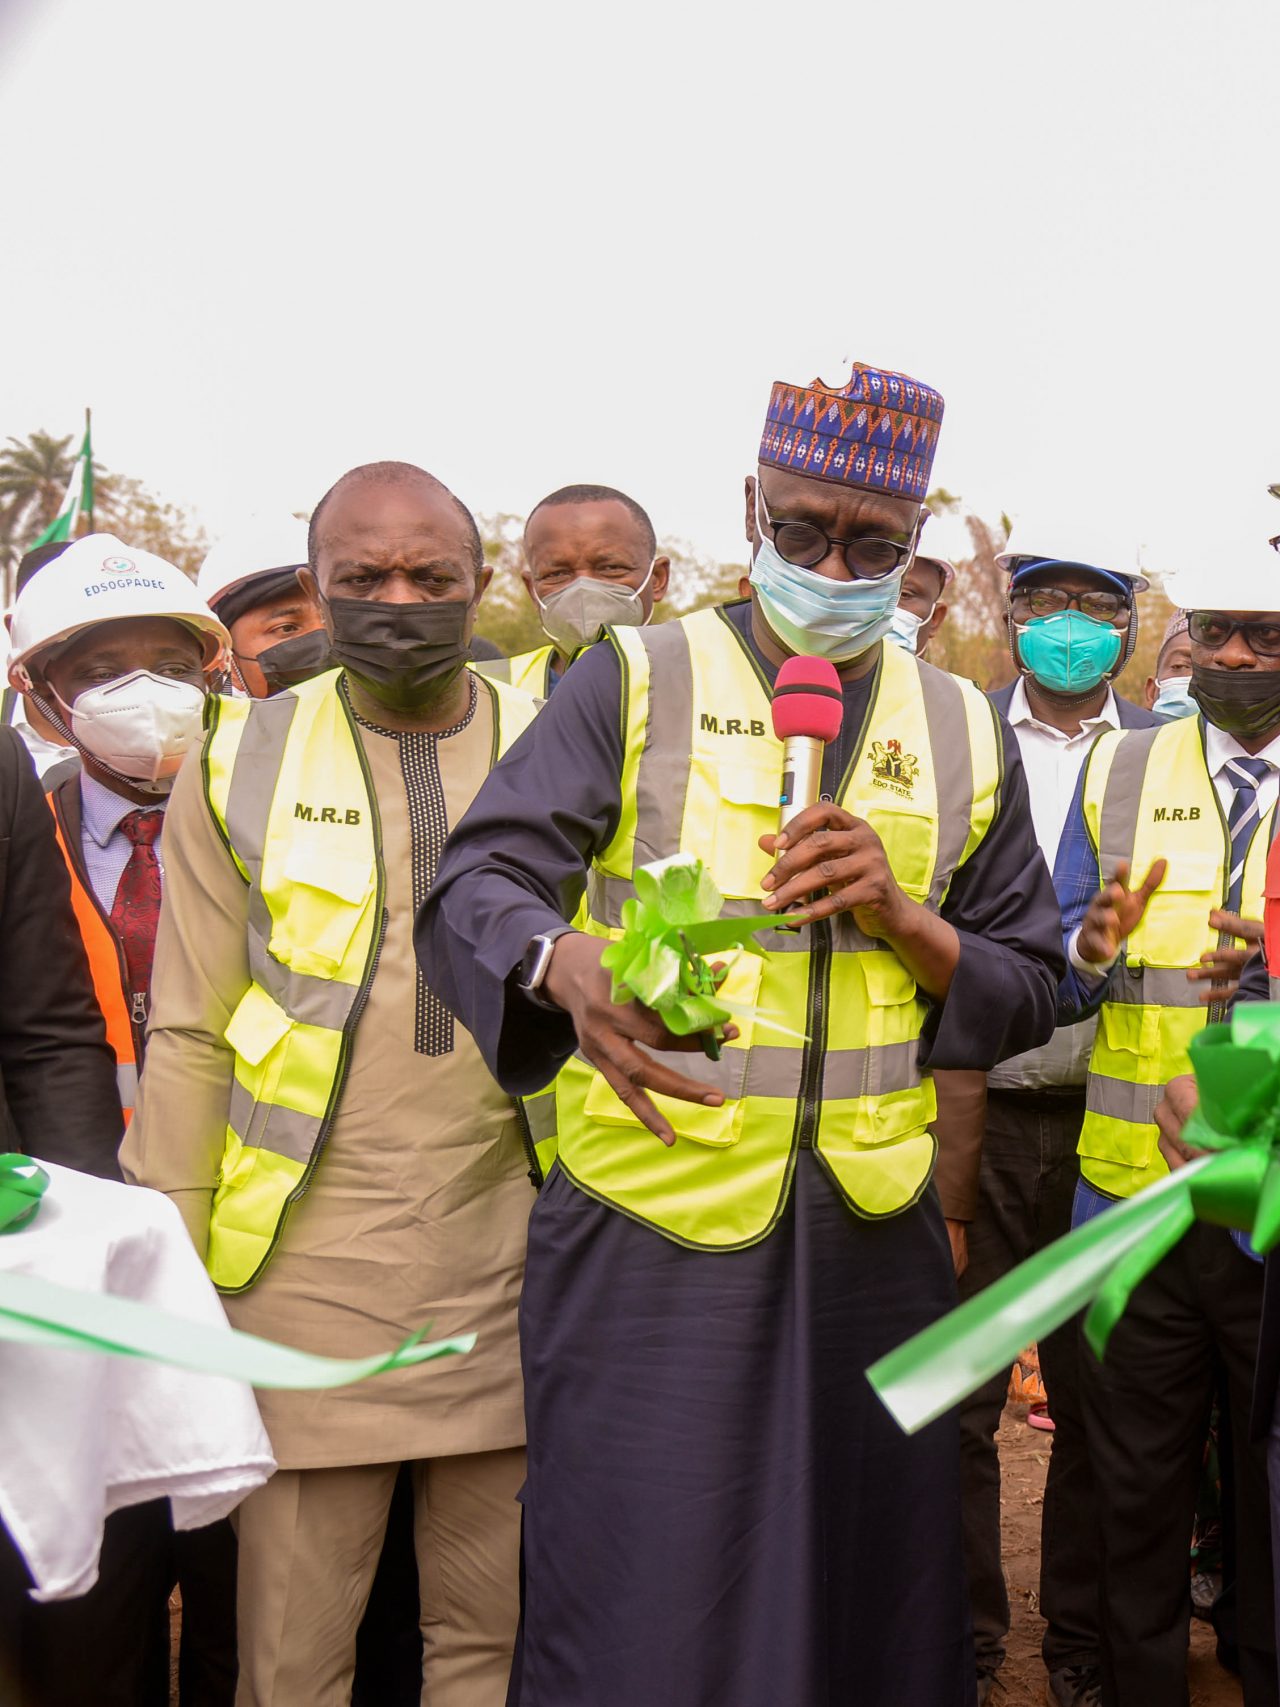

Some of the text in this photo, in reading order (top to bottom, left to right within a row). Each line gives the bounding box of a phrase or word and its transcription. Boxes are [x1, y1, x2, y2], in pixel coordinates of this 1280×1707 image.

[84, 578, 165, 597] EDSOGPADEC
[699, 713, 766, 737] M.R.B
[294, 802, 361, 826] M.R.B
[1153, 806, 1201, 823] M.R.B
